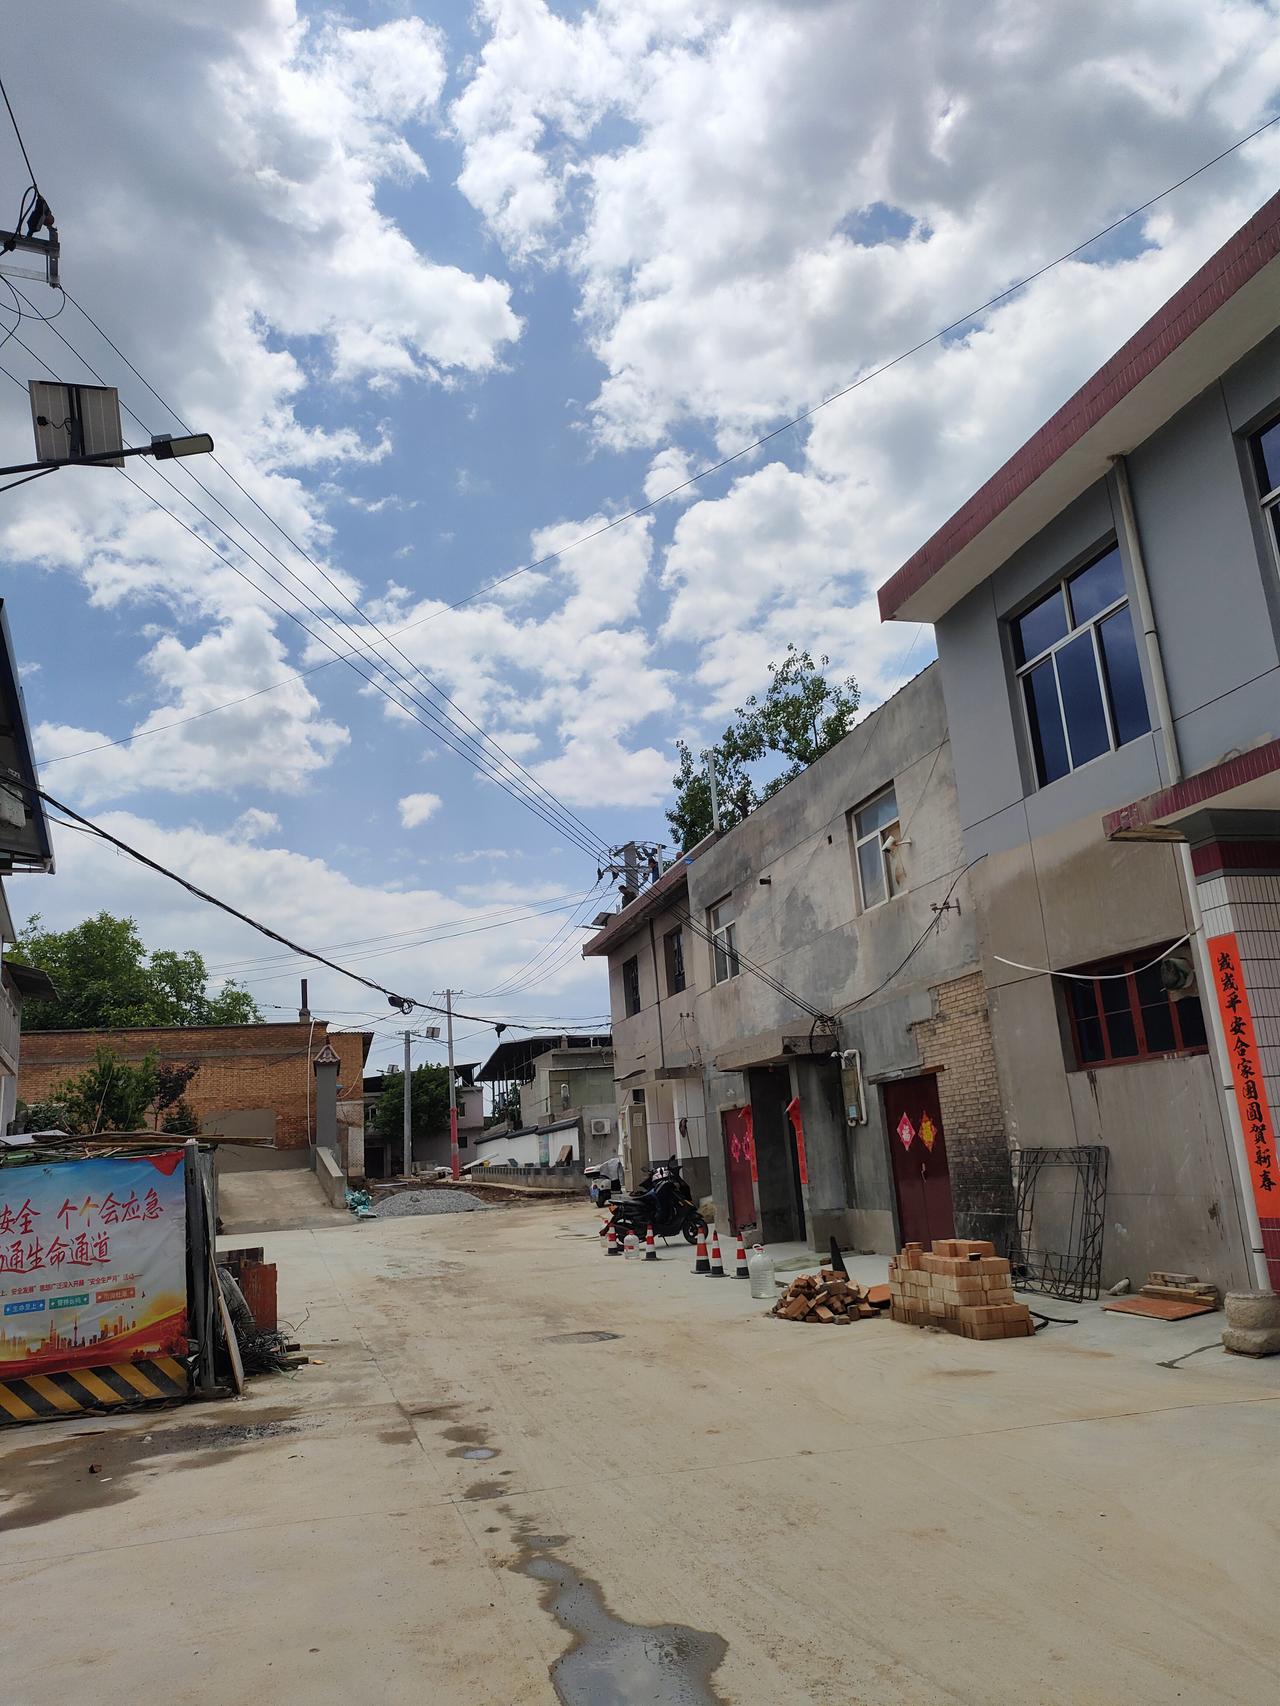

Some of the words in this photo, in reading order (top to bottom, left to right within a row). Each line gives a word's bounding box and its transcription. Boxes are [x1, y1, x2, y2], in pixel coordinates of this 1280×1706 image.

[57, 1187, 164, 1231] 个个会应急
